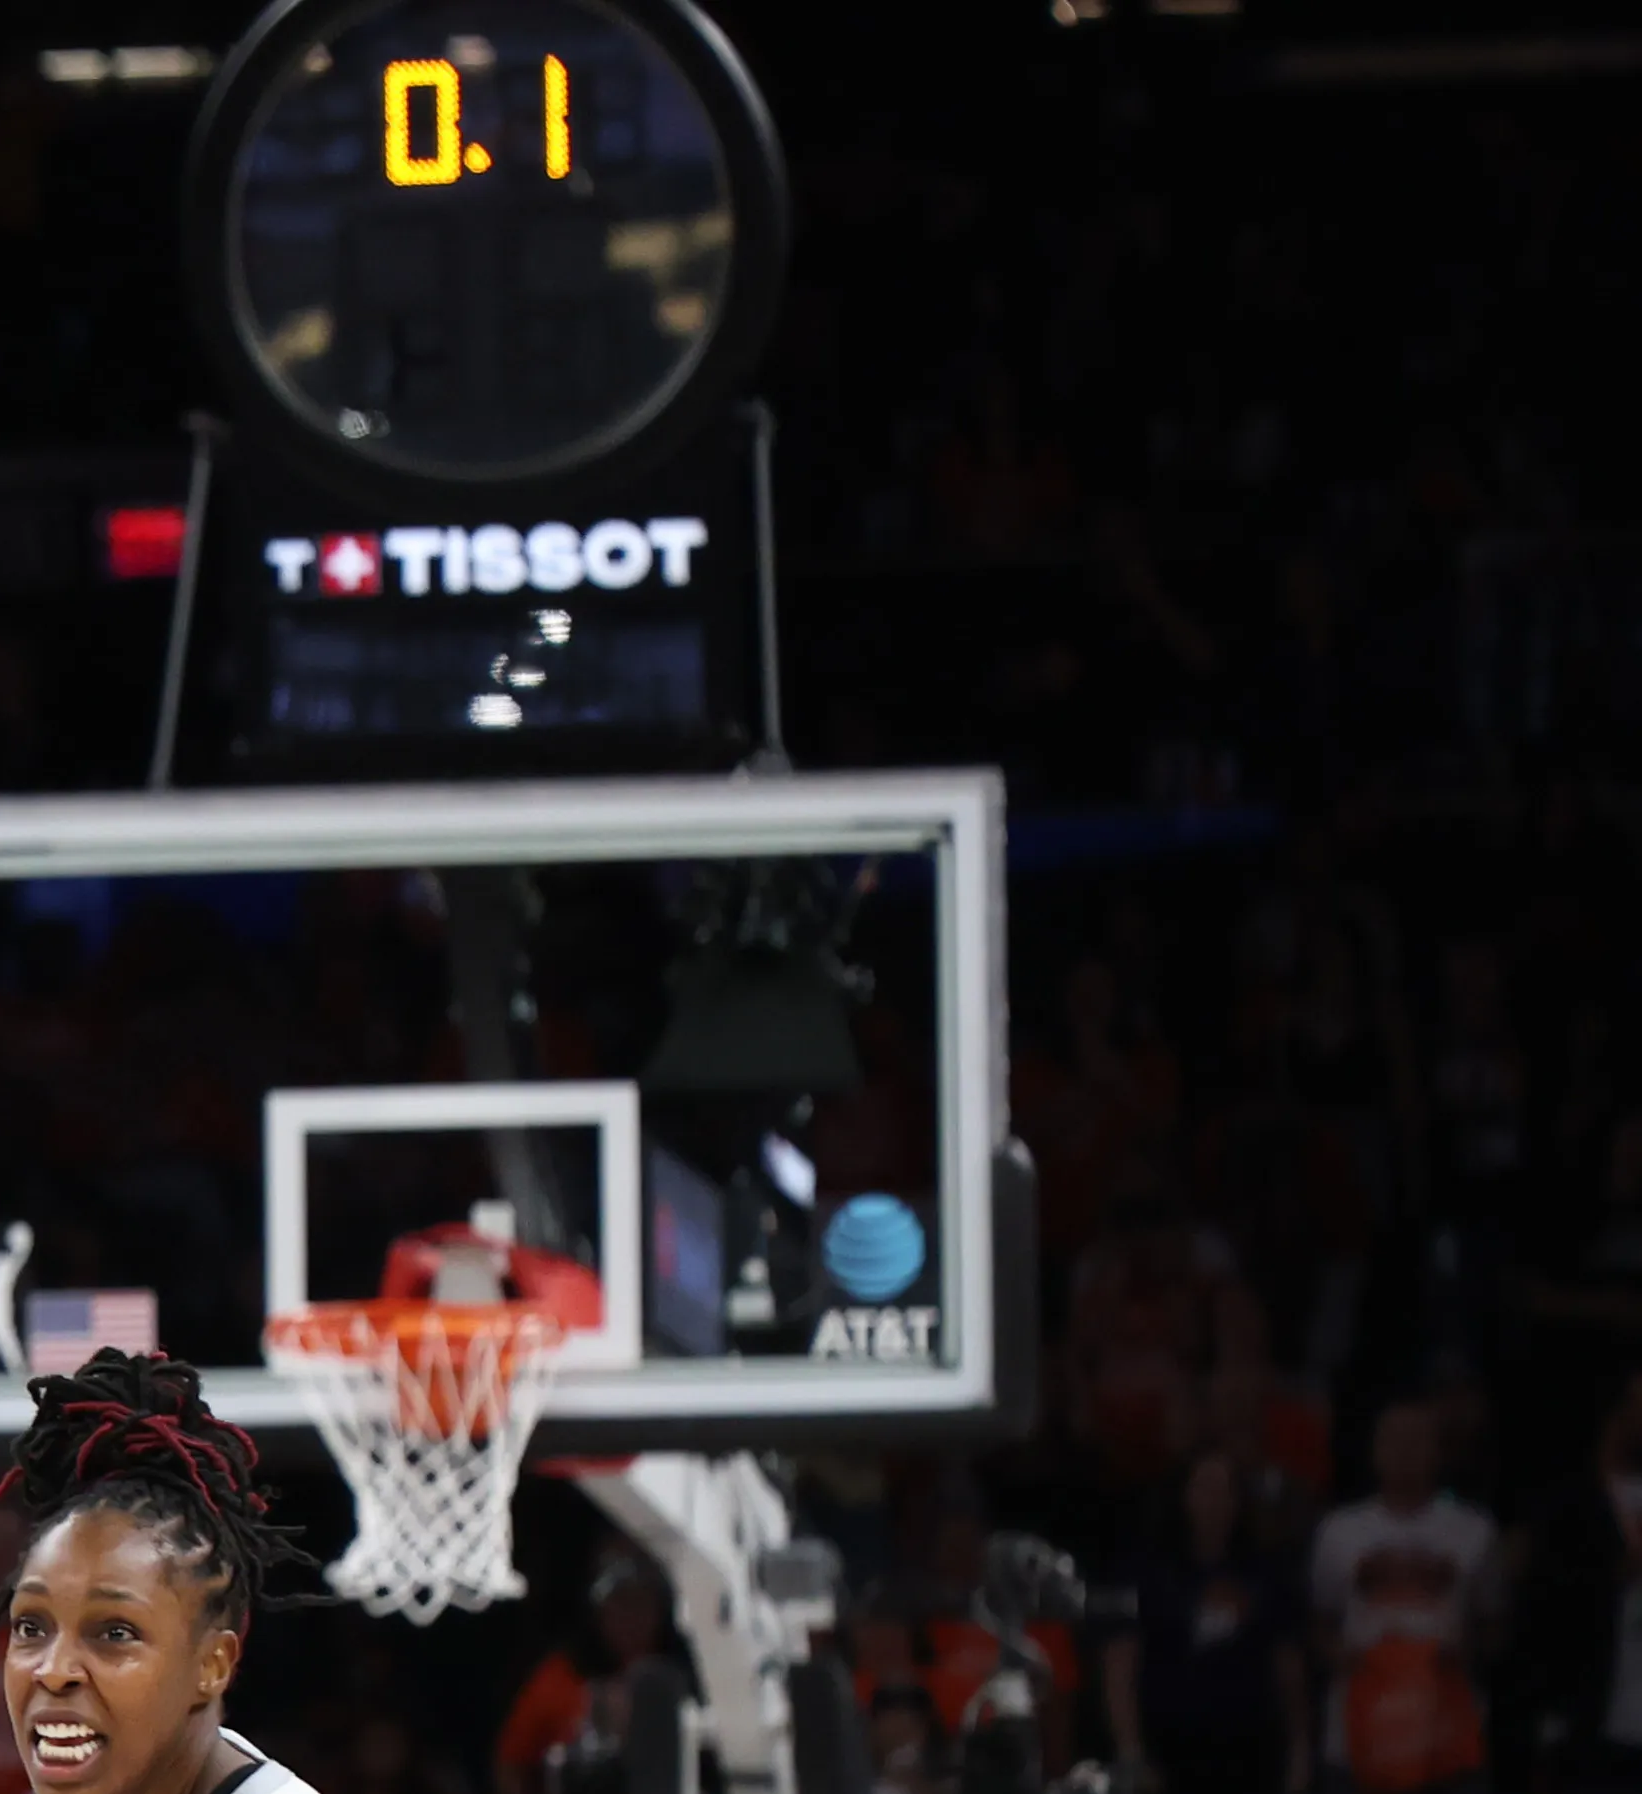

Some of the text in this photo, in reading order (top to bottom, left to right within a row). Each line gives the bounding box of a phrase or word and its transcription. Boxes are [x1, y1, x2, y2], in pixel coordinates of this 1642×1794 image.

[384, 53, 571, 186] 0.1
[384, 516, 708, 597] TISSOT
[809, 1306, 940, 1362] AT&T
